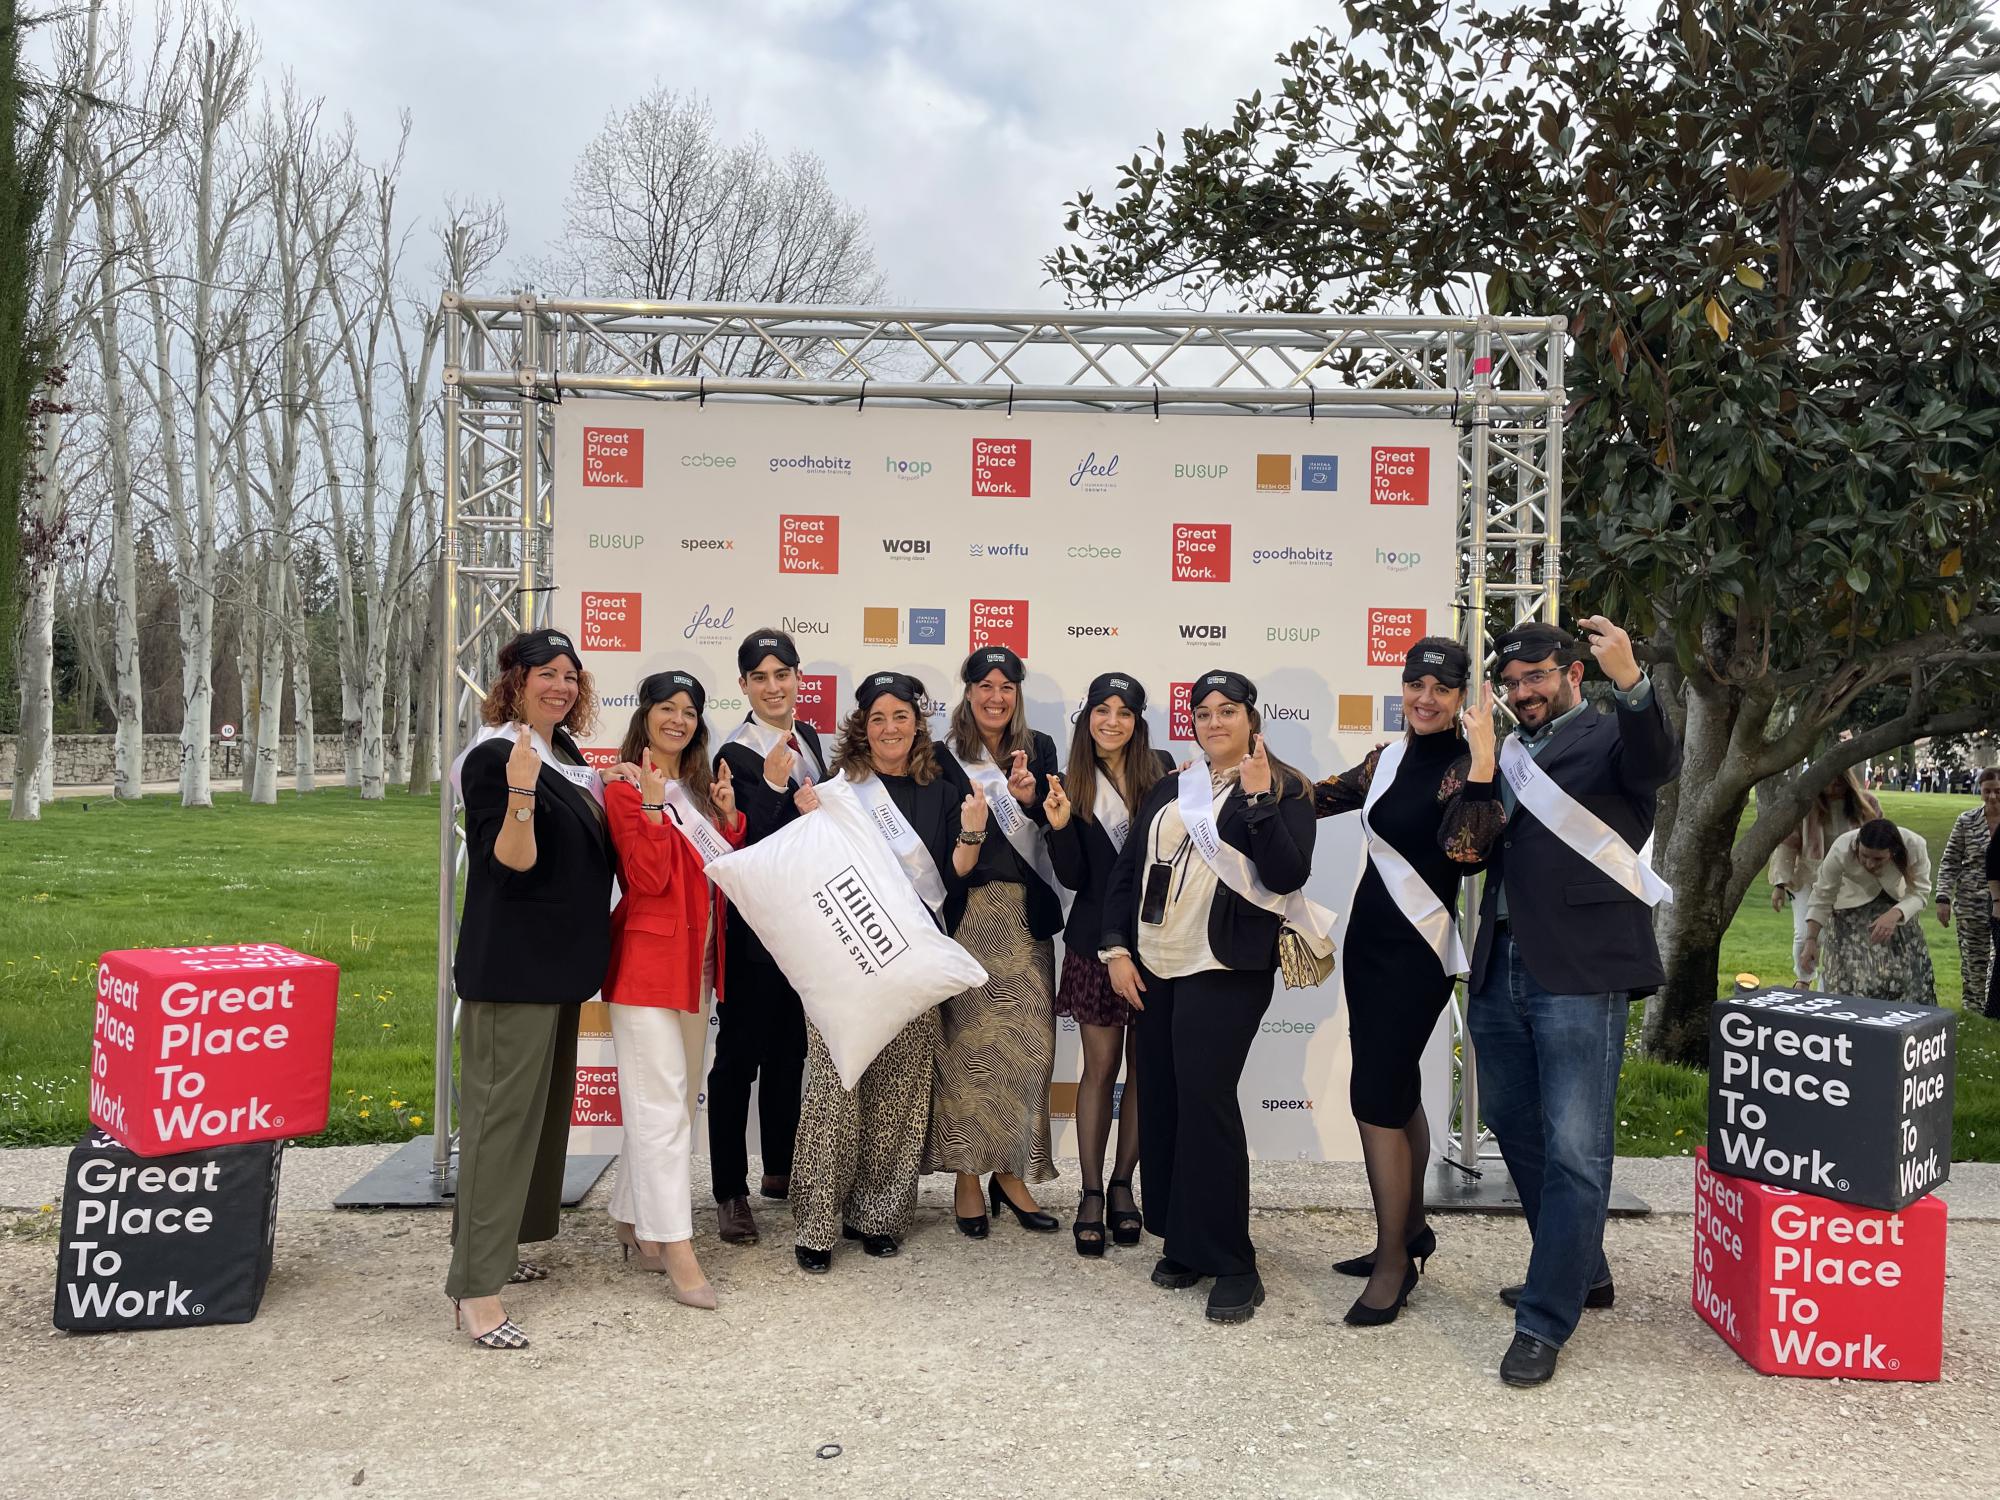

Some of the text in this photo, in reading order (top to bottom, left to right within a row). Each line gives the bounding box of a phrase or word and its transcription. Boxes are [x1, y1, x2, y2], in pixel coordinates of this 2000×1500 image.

[587, 431, 629, 444] Great
[588, 445, 628, 456] Place
[977, 442, 1017, 454] Great
[587, 458, 603, 469] To
[681, 453, 736, 468] cobee
[770, 456, 851, 472] goodhabitz
[977, 455, 1016, 467] Place
[1375, 450, 1415, 463] Great
[887, 457, 932, 476] hoop
[976, 468, 991, 480] To
[1070, 452, 1120, 487] ifeel
[1175, 464, 1229, 479] BUSUP
[1375, 464, 1415, 475] Place
[1375, 476, 1390, 488] To
[784, 519, 825, 531] Great
[590, 534, 644, 549] BUSUP
[784, 532, 824, 544] Place
[1177, 528, 1217, 540] Great
[681, 538, 734, 551] speexx
[784, 545, 799, 556] To
[883, 540, 931, 554] WOBI
[988, 544, 1029, 556] woffu
[1068, 545, 1122, 559] cobee
[1177, 540, 1216, 552] Place
[1177, 554, 1192, 565] To
[1253, 548, 1333, 564] goodhabitz
[1376, 548, 1421, 568] hoop
[586, 596, 627, 608] Great
[974, 603, 1014, 615] Great
[586, 609, 626, 621] Place
[684, 604, 735, 639] ifeel
[975, 616, 1013, 628] Place
[1372, 612, 1412, 624] Great
[586, 622, 601, 633] To
[782, 617, 830, 634] Nexu
[1068, 625, 1119, 638] speexx
[1179, 625, 1227, 639] WOBI
[1373, 625, 1411, 637] Place
[974, 629, 989, 641] To
[1267, 628, 1320, 642] BUSUP
[1372, 638, 1387, 649] To
[1264, 704, 1310, 720] Nexu
[1001, 799, 1020, 828] Hilton
[880, 808, 899, 835] Hilton
[698, 829, 720, 857] Hilton
[1199, 823, 1215, 853] Hilton
[813, 891, 834, 918] FOR
[832, 918, 853, 945] THE
[836, 877, 893, 957] Hilton
[97, 963, 139, 1012] Great
[161, 978, 295, 1018] Great
[95, 1002, 136, 1052] Place
[1261, 1019, 1316, 1034] cobee
[160, 1021, 289, 1060] Place
[1719, 1012, 1853, 1067] Great
[1903, 1027, 1947, 1072] Great
[92, 1040, 108, 1079] To
[154, 1064, 206, 1101] To
[576, 1071, 617, 1082] Great
[1723, 1050, 1851, 1107] Place
[577, 1084, 616, 1095] Place
[1902, 1072, 1944, 1115] Place
[576, 1097, 591, 1109] To
[1262, 1100, 1313, 1112] speexx
[1719, 1089, 1768, 1130] To
[1901, 1119, 1918, 1155] To
[77, 1158, 221, 1194] Great
[1697, 1158, 1744, 1224] Great
[75, 1199, 213, 1236] Place
[1771, 1204, 1905, 1246] Great
[1698, 1199, 1743, 1262] Place
[69, 1240, 122, 1277] To
[1697, 1235, 1713, 1273] To
[1774, 1247, 1903, 1288] Place
[1770, 1287, 1820, 1326] To
